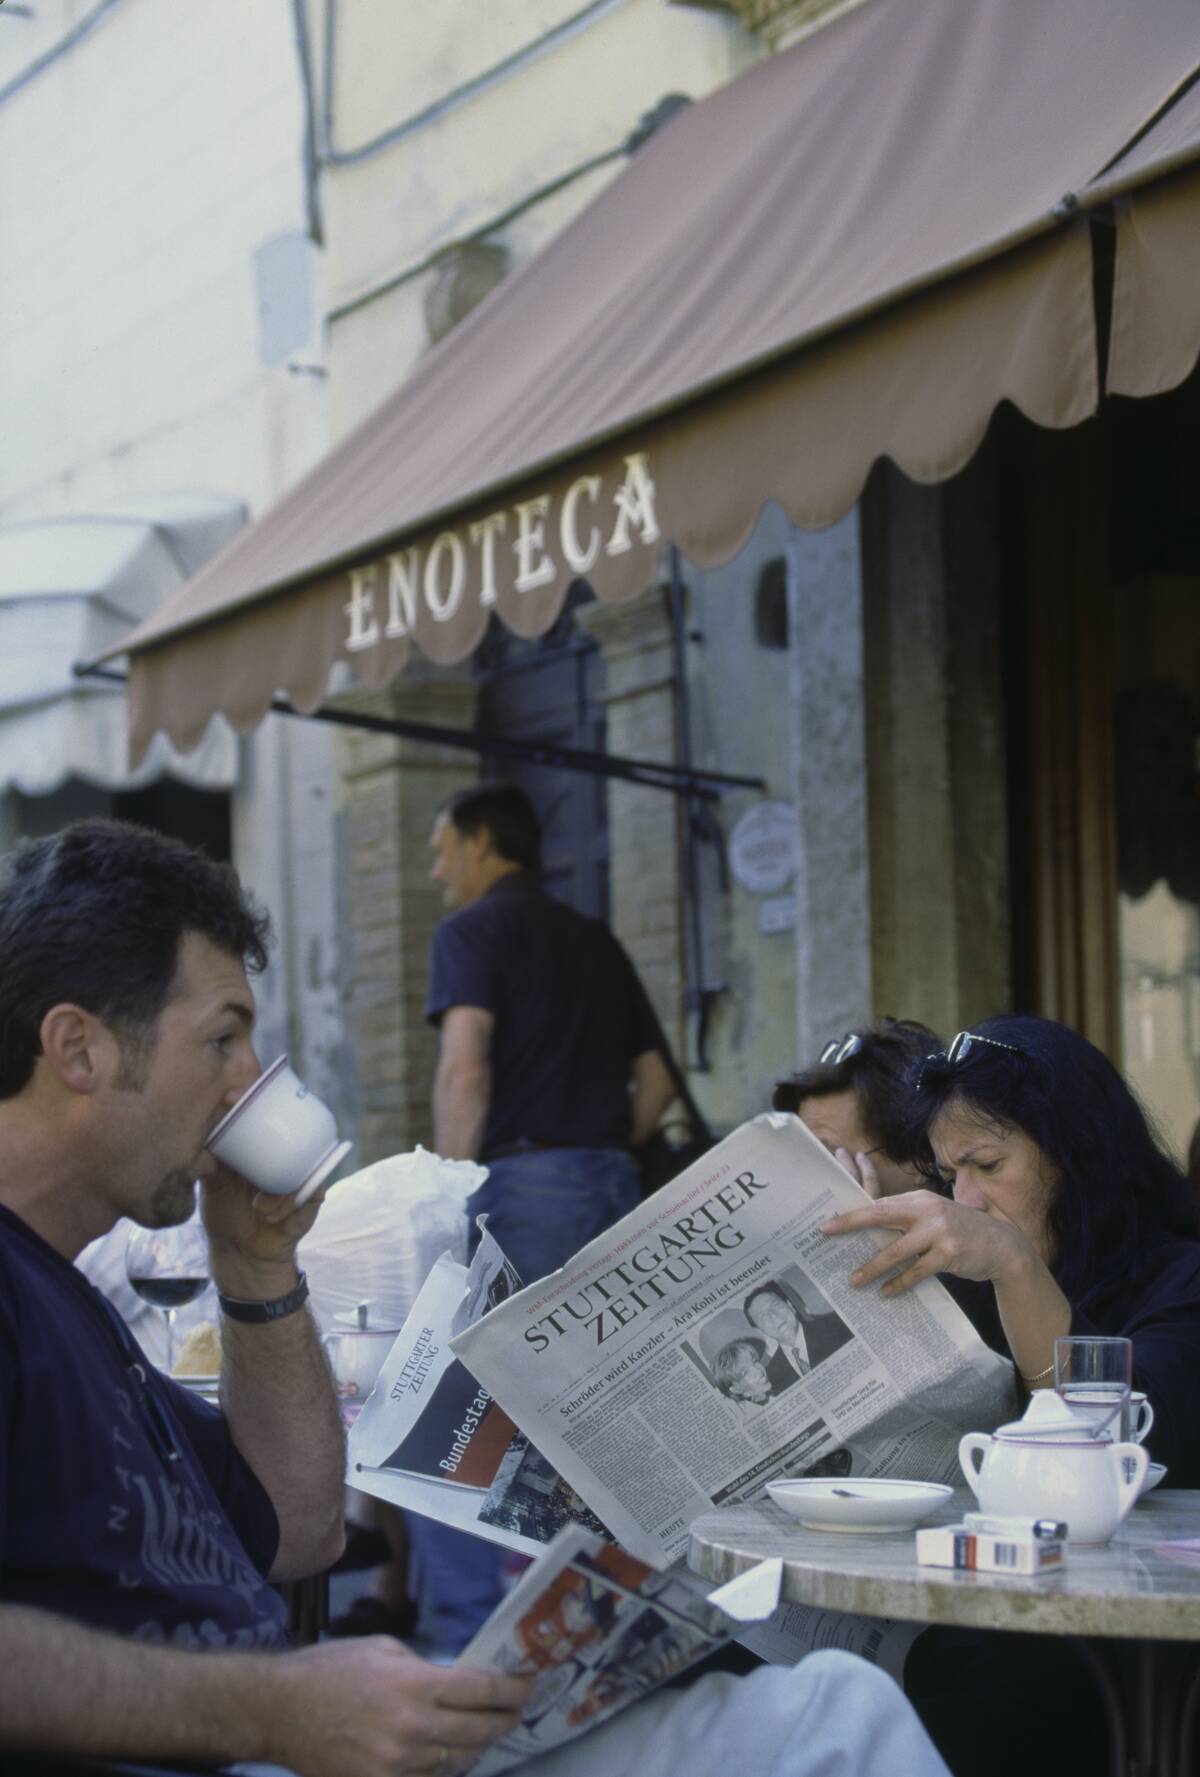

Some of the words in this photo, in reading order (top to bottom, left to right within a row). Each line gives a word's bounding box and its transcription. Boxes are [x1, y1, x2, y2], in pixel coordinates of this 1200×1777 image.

[345, 452, 660, 652] ENOTECA
[524, 1170, 770, 1354] STUTTGARTER
[584, 1224, 745, 1346] ZEITUNG
[391, 1327, 435, 1401] STUTTGARTER
[408, 1345, 440, 1394] ZEITUNG
[560, 1380, 604, 1416] Schröder
[605, 1361, 628, 1381] wird
[627, 1332, 665, 1364] Kanzler
[674, 1311, 693, 1330] Ära
[692, 1293, 716, 1313] Kohl
[716, 1285, 730, 1296] ist
[729, 1257, 771, 1286] beendet
[658, 1516, 686, 1539] HEUTE
